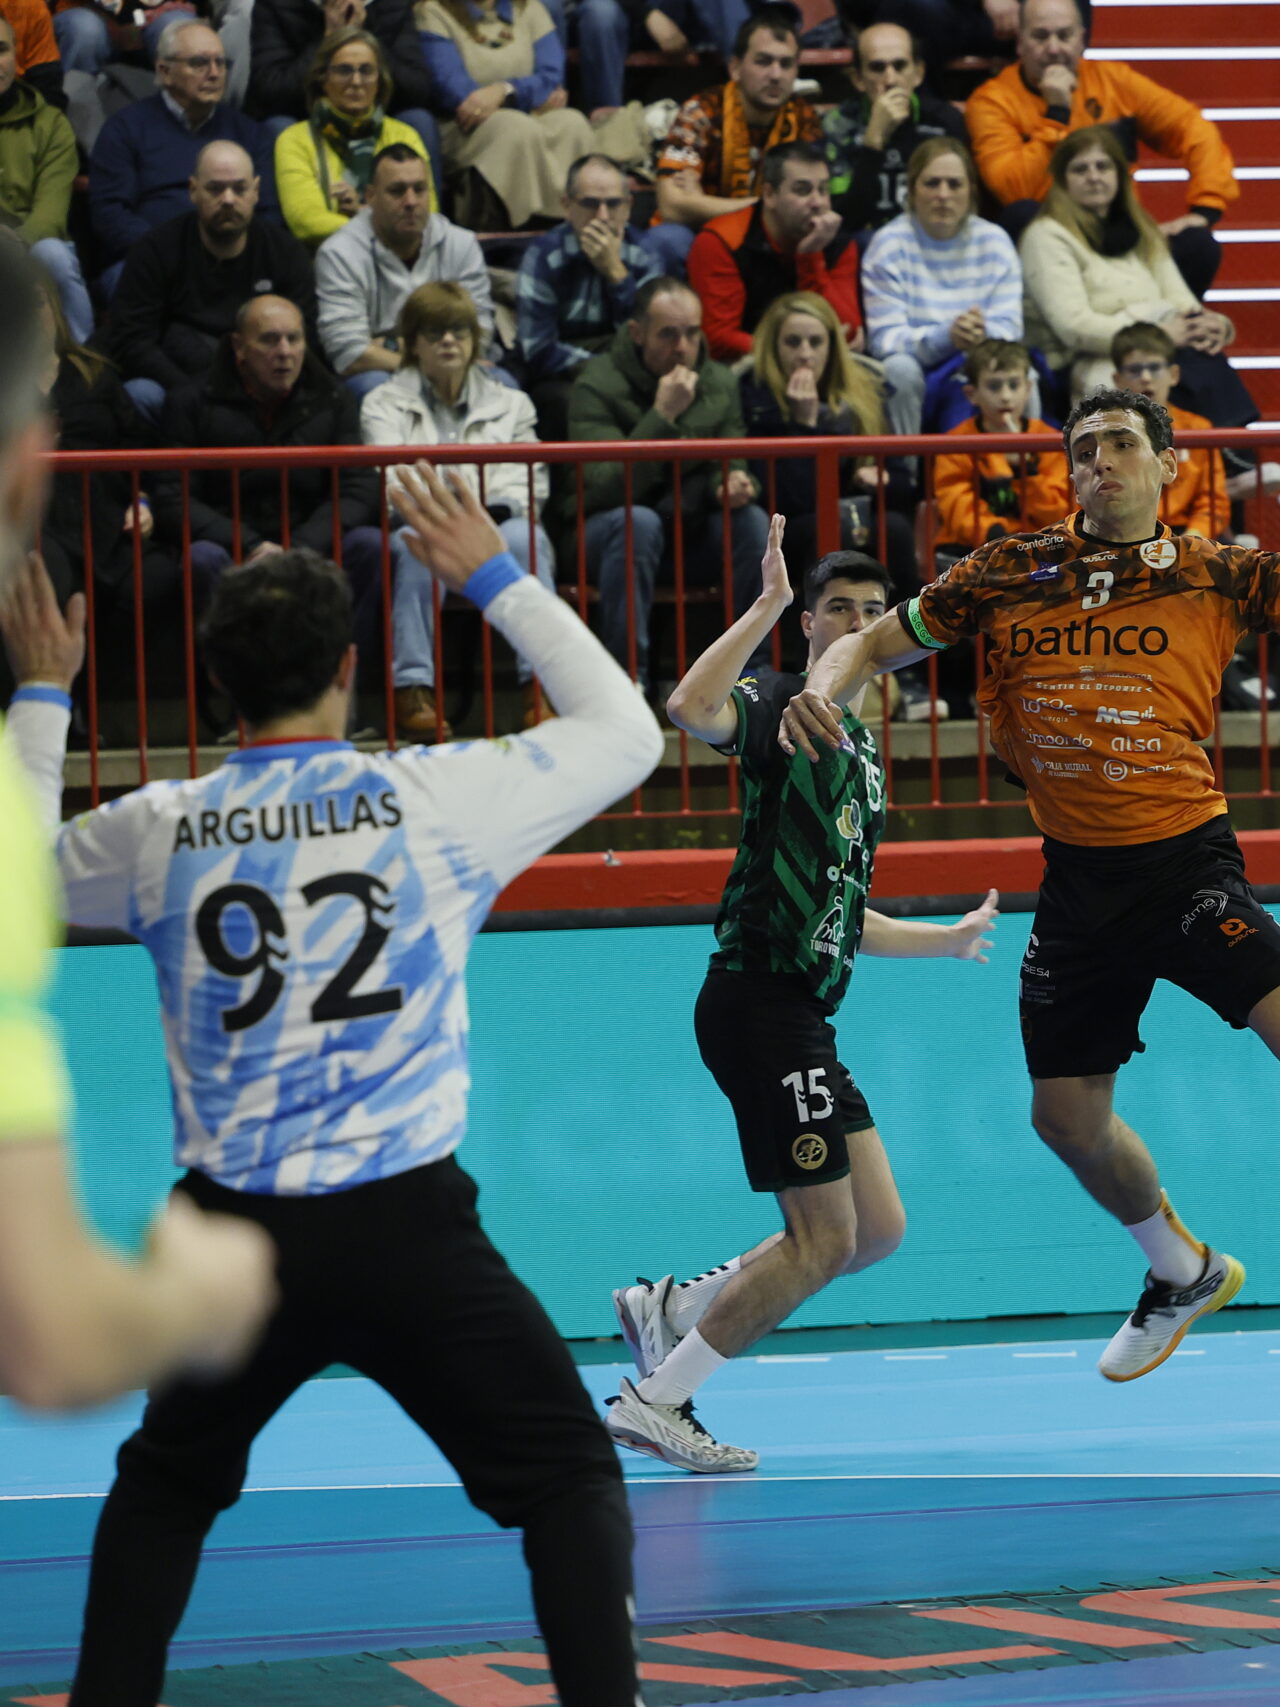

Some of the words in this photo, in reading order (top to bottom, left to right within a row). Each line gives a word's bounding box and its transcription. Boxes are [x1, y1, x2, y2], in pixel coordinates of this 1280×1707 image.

[1081, 571, 1115, 610] 3
[1010, 616, 1168, 657] bathco
[1111, 736, 1161, 752] alsa
[172, 792, 401, 854] ARGUILLAS
[195, 872, 403, 1033] 92
[780, 1067, 835, 1123] 15
